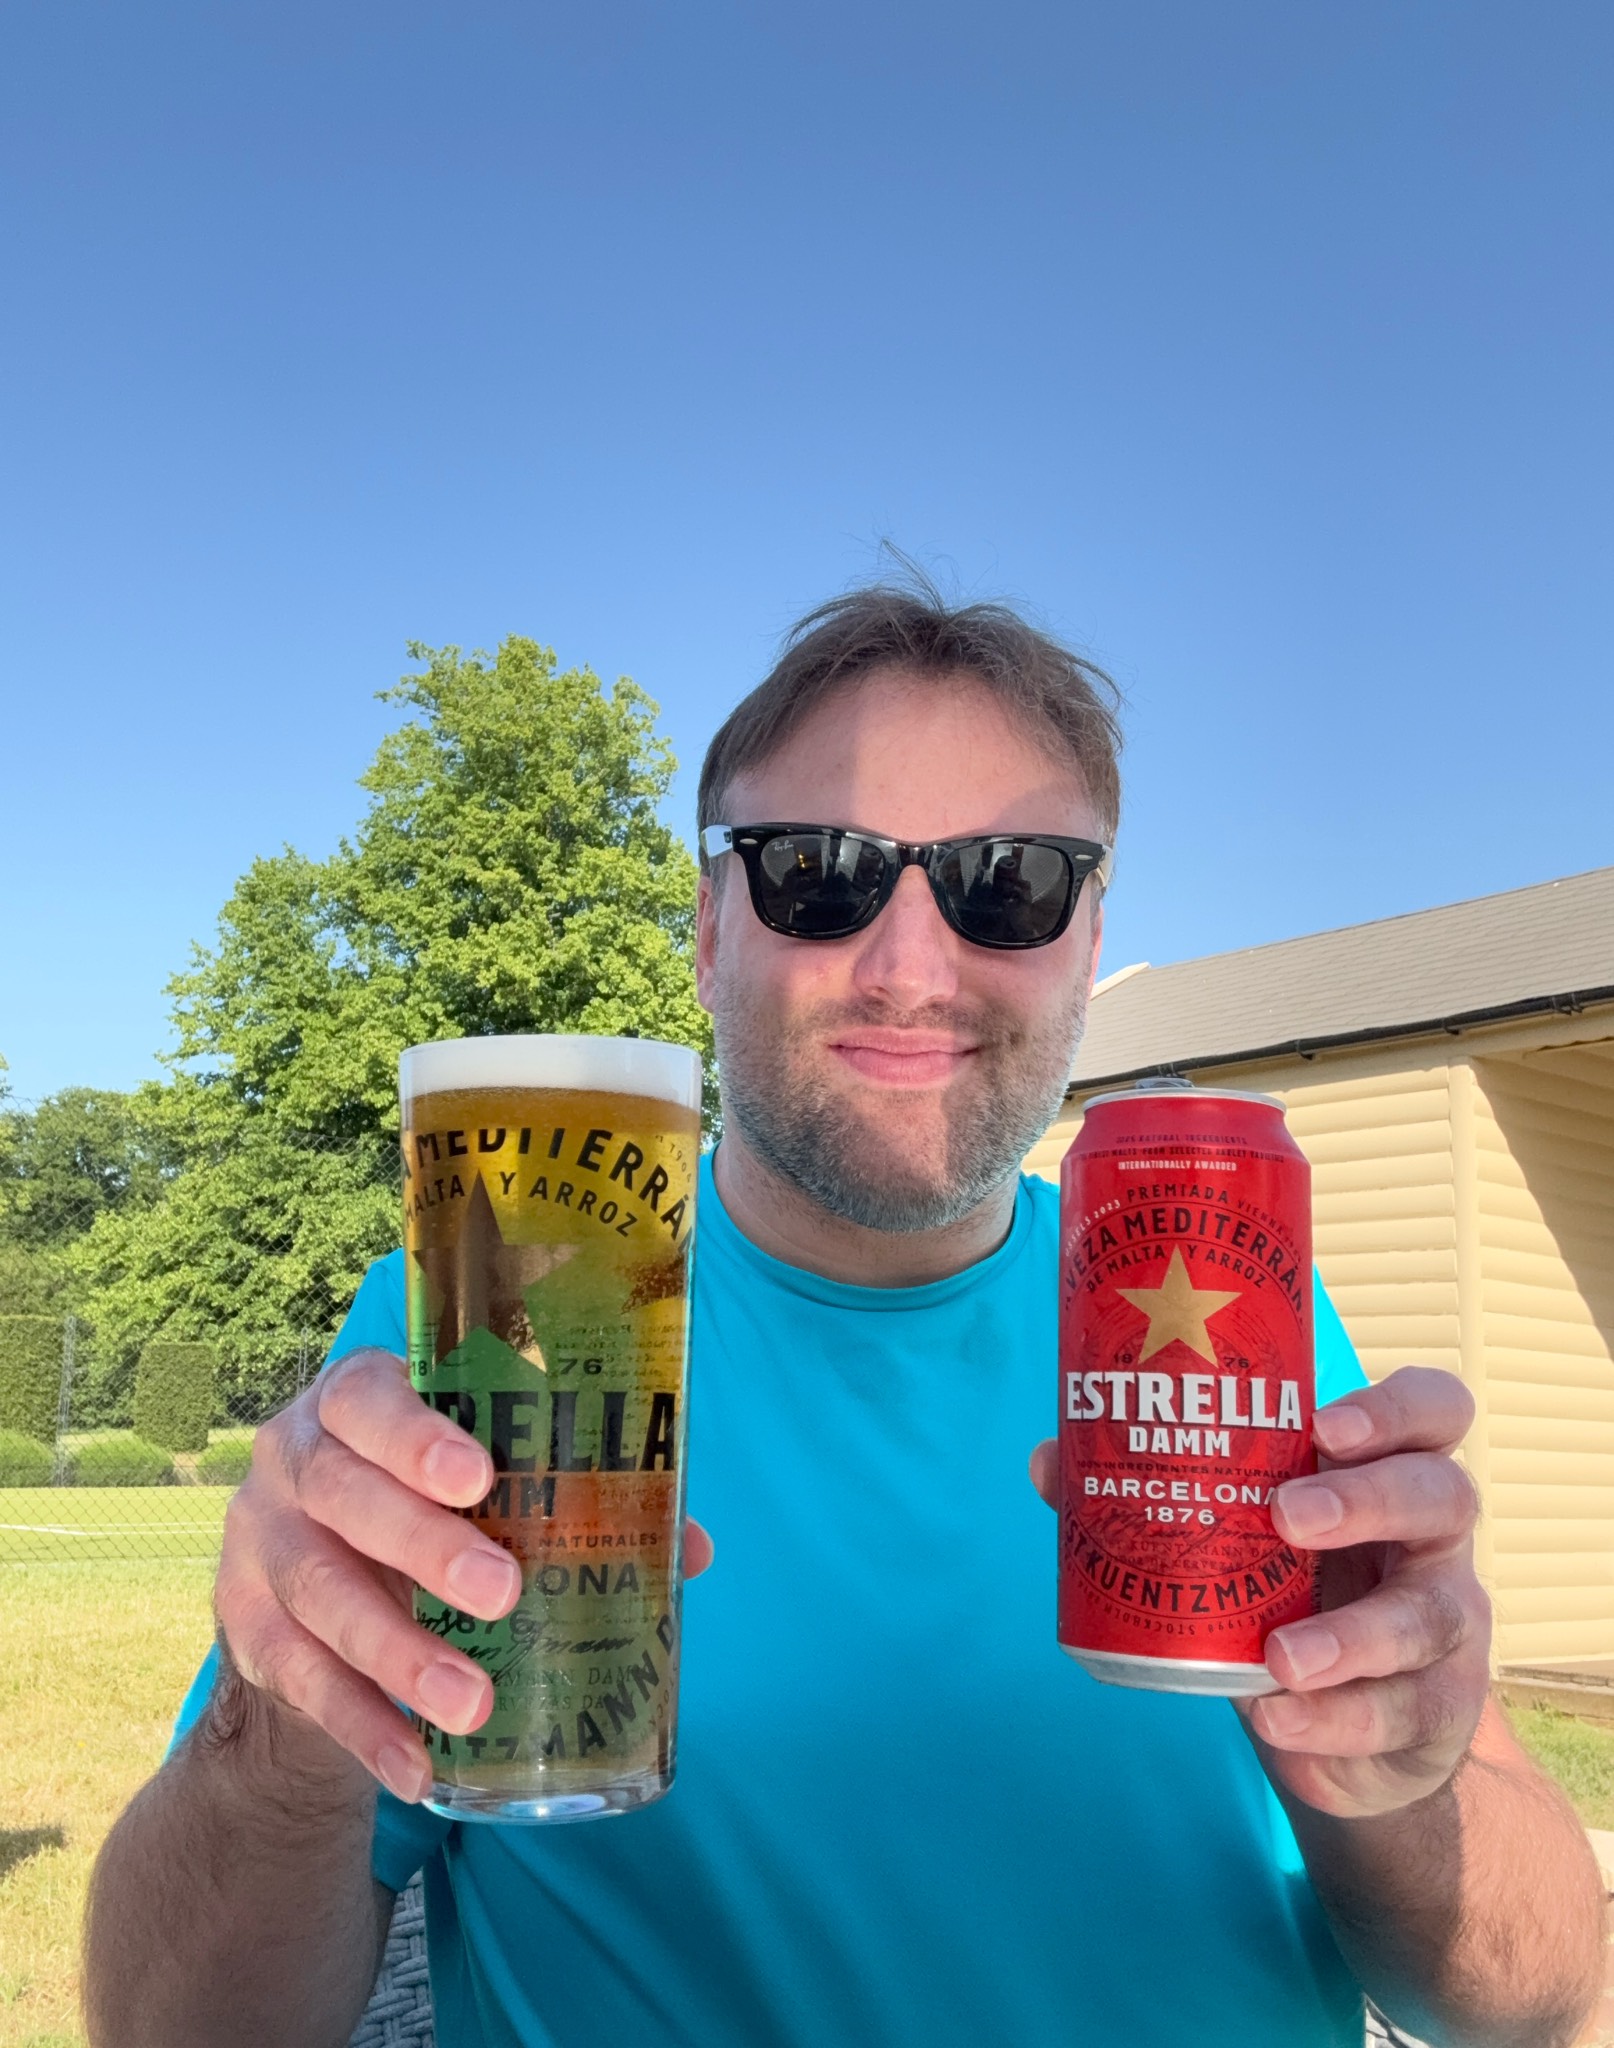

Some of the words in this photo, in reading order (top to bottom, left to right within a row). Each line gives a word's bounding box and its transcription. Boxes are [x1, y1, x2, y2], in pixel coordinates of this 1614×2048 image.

[1118, 1159, 1191, 1171] INTERNATIONALLY
[1194, 1160, 1237, 1172] AWARDED
[500, 1172, 516, 1195] Y
[528, 1176, 638, 1238] ARROZ
[1127, 1183, 1229, 1204] PREMIADA
[1093, 1199, 1121, 1219] 2023
[1065, 1225, 1118, 1300] VEZA
[1122, 1206, 1304, 1316] MEDITERRÁN
[1086, 1270, 1104, 1293] DE
[1107, 1244, 1165, 1276] MALTA
[1187, 1244, 1198, 1260] Y
[1205, 1248, 1267, 1289] ARROZ
[558, 1357, 603, 1376] 76
[1224, 1356, 1249, 1369] 76
[1066, 1371, 1303, 1430] ESTRELLA
[419, 1391, 676, 1473] RELLA
[1128, 1426, 1230, 1458] DAMM
[1103, 1461, 1214, 1474] INGREDIENTES
[1214, 1466, 1291, 1479] NATURALES
[1144, 1506, 1216, 1526] 1876
[539, 1532, 658, 1550] NATURALES
[1085, 1545, 1298, 1613] KUENTZMANN
[1103, 1603, 1196, 1635] STOCKHOLM
